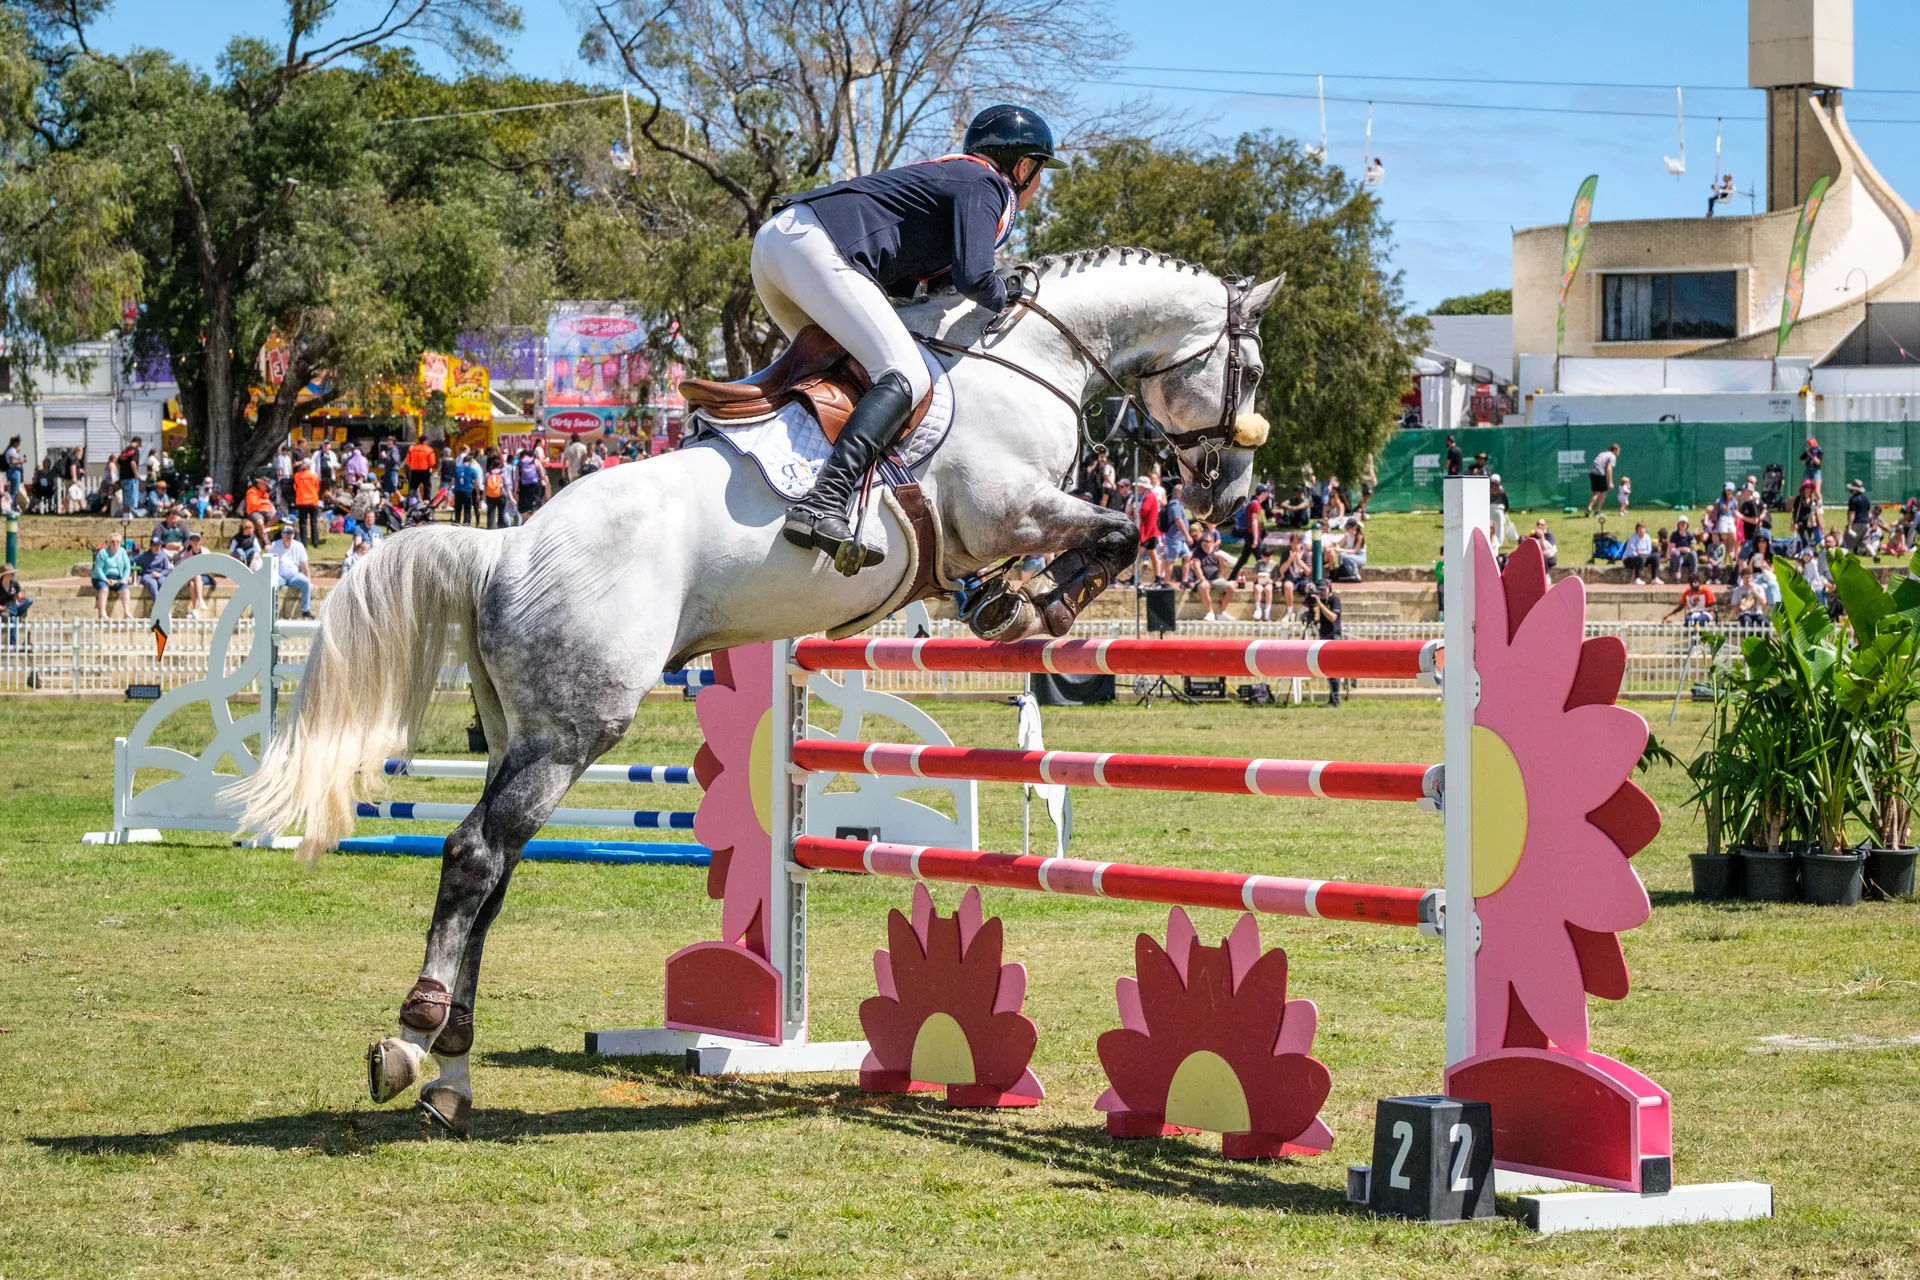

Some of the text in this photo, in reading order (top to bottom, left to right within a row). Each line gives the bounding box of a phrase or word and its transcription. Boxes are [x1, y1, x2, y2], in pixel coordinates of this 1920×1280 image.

[551, 417, 572, 429] Dirty
[1390, 1120, 1413, 1190] 2
[1449, 1123, 1474, 1192] 2
